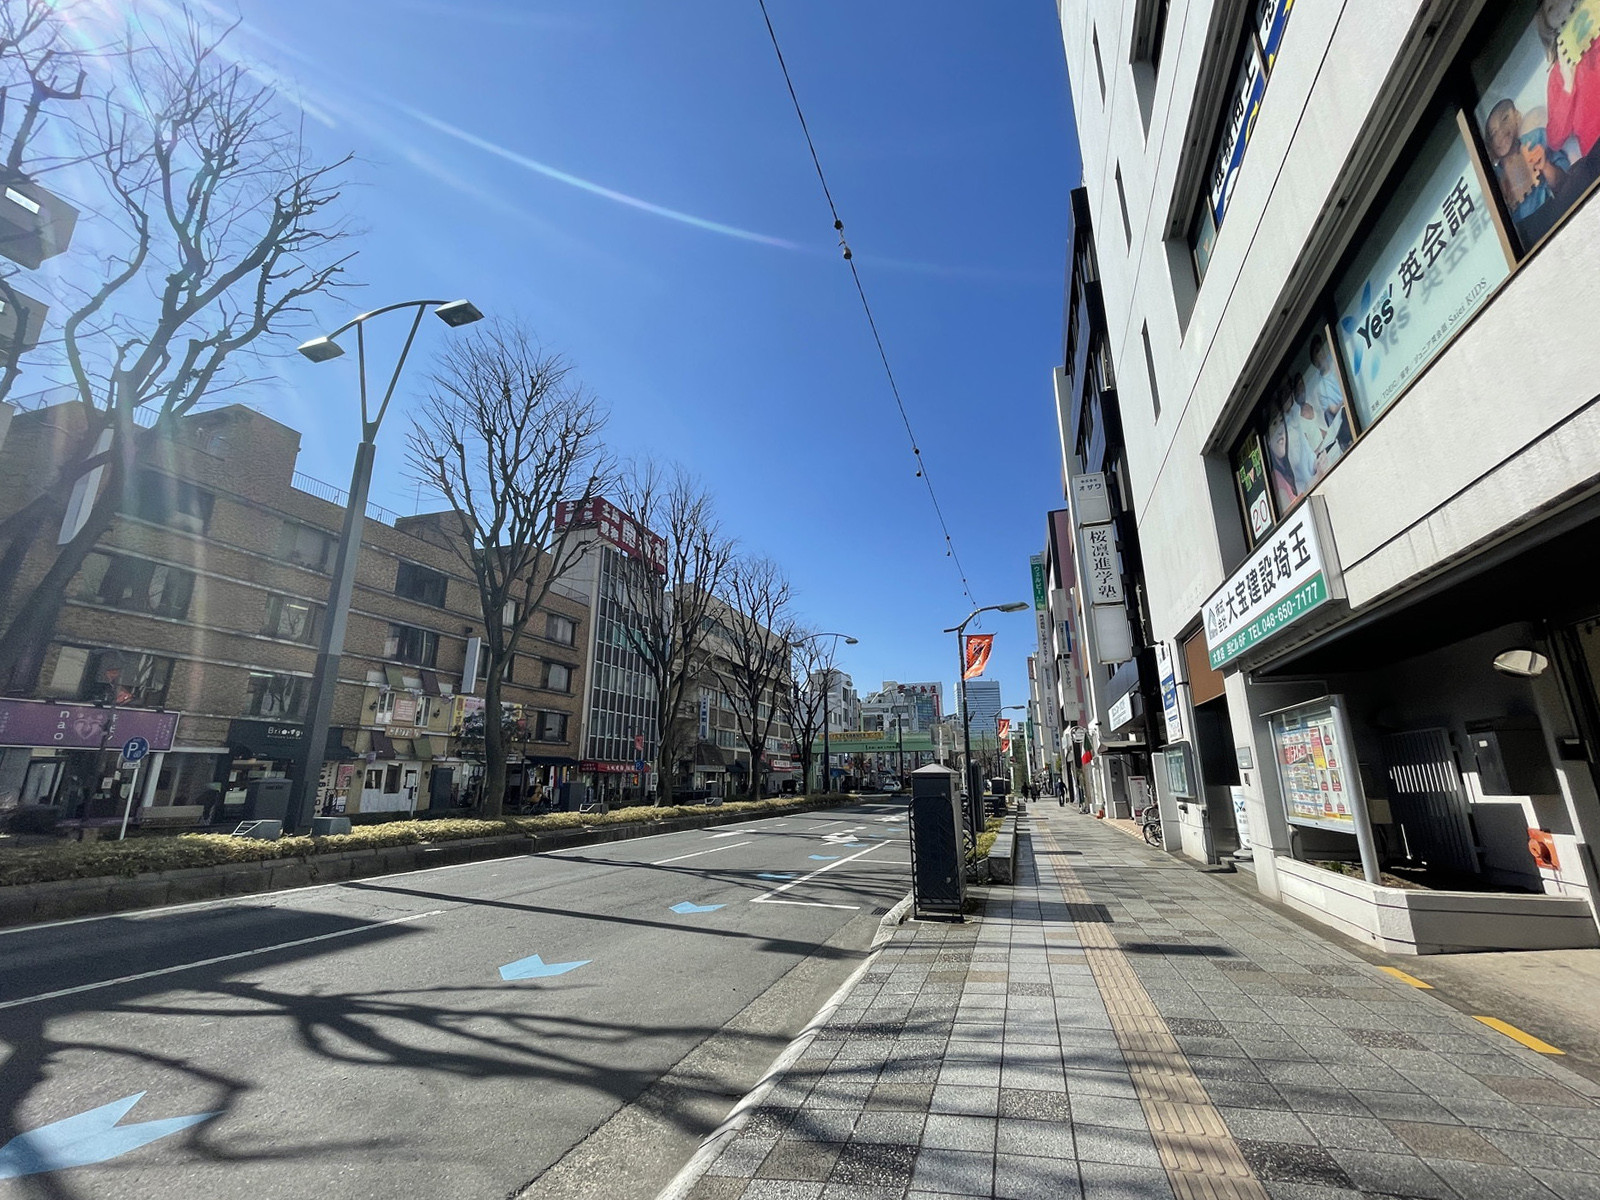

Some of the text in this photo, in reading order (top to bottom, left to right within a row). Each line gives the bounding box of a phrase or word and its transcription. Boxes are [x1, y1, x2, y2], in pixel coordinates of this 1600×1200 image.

[1398, 176, 1476, 299] 英会話
[1465, 277, 1488, 307] KIDS
[1079, 483, 1102, 491] オザワ
[1225, 520, 1312, 624] 大宝建設埼玉
[1249, 623, 1263, 641] TEL
[1261, 581, 1318, 633] 048-650-7177
[126, 742, 139, 758] P
